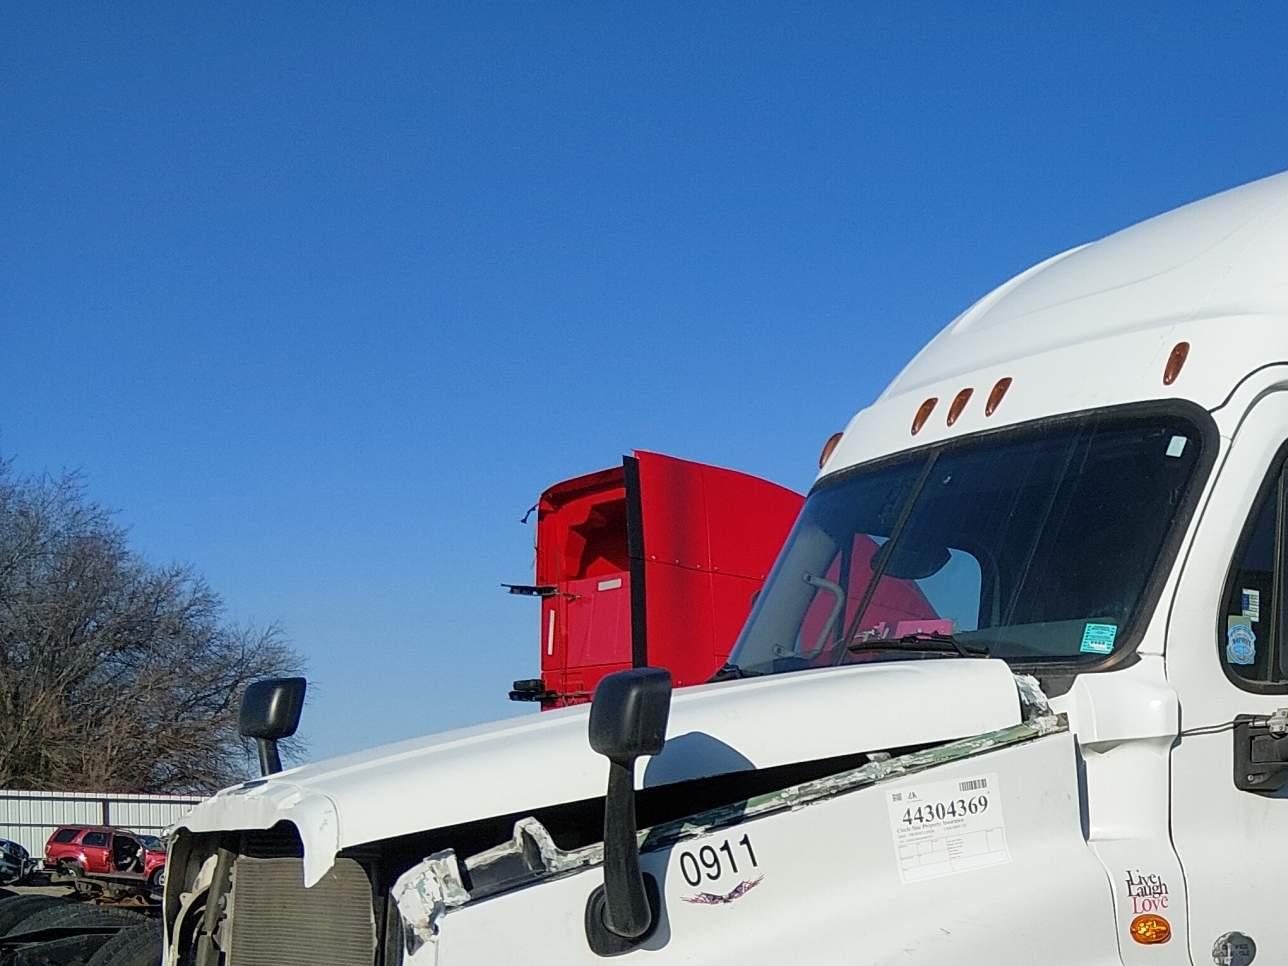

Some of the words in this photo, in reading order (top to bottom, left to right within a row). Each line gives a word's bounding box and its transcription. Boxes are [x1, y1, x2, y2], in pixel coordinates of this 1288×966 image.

[902, 794, 988, 825] 44304369
[680, 833, 757, 887] 0911
[1126, 870, 1157, 886] Live
[1126, 876, 1168, 898] Laugh
[1132, 895, 1168, 914] Love
